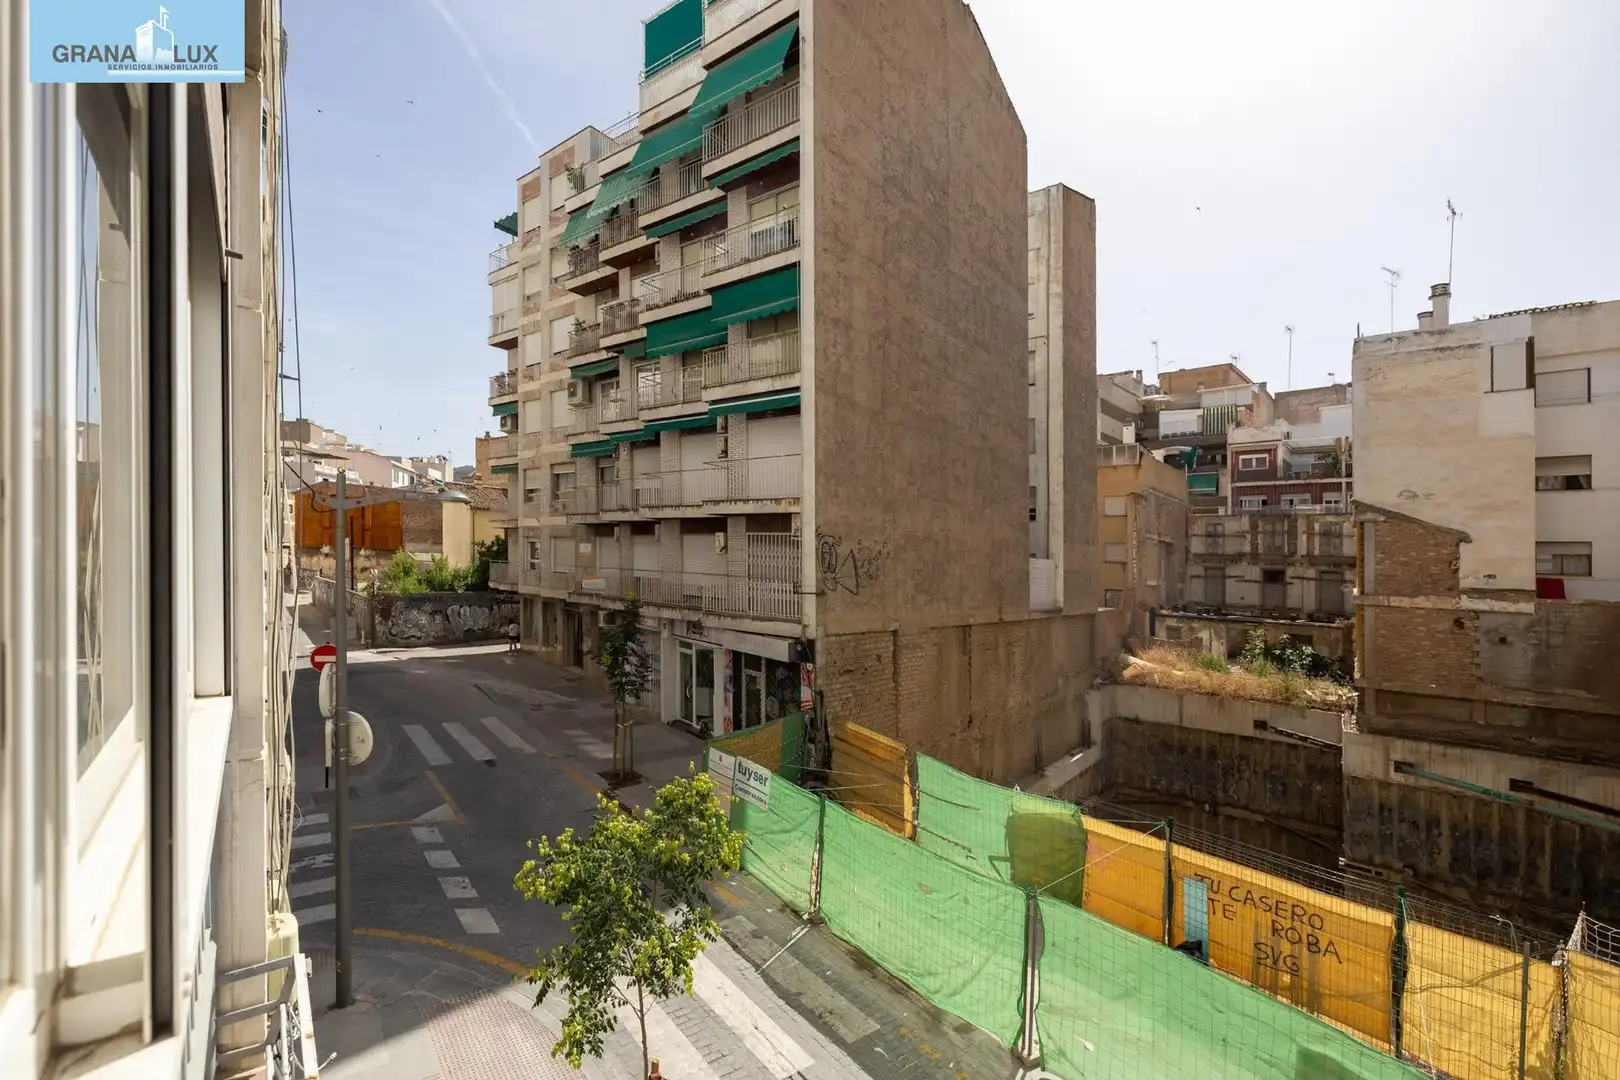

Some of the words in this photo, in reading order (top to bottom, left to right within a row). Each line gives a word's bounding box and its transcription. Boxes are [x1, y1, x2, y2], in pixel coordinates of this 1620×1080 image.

[738, 760, 769, 787] tuyser
[1228, 885, 1324, 931] CASERO
[1208, 898, 1237, 921] TE
[1271, 919, 1343, 965] ROBA
